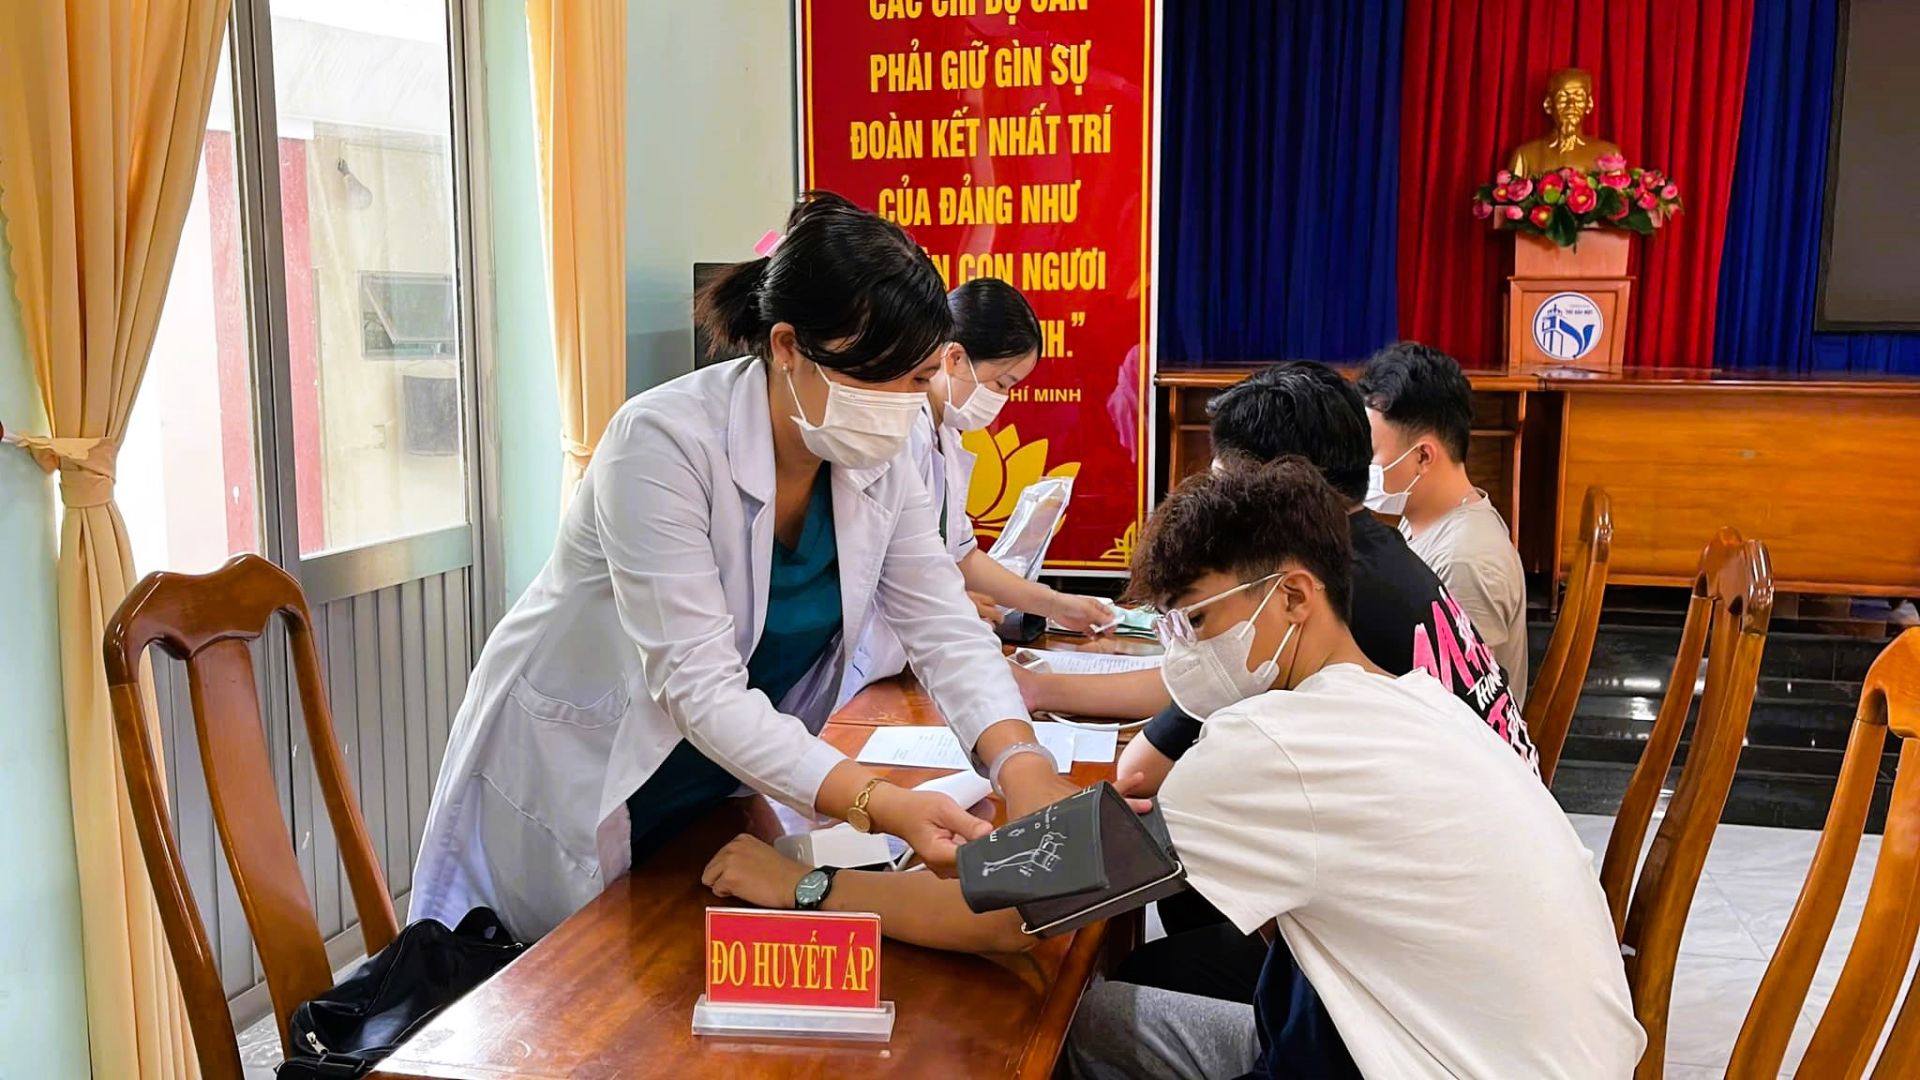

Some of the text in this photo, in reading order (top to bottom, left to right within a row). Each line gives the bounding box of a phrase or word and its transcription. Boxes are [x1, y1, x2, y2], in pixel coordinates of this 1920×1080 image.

[870, 38, 1092, 95] PHẢI GIỮ GÌN SỰ
[850, 103, 1114, 160] ĐOÀN KẾT NHẤT TRÍ
[879, 173, 1081, 227] CỦA ĐẢNG NHƯ
[959, 253, 1014, 287] CON
[1022, 247, 1106, 291] NGƯƠI
[1010, 386, 1081, 402] HÍ MINH
[711, 930, 874, 991] ĐO HUYẾT ÁP
